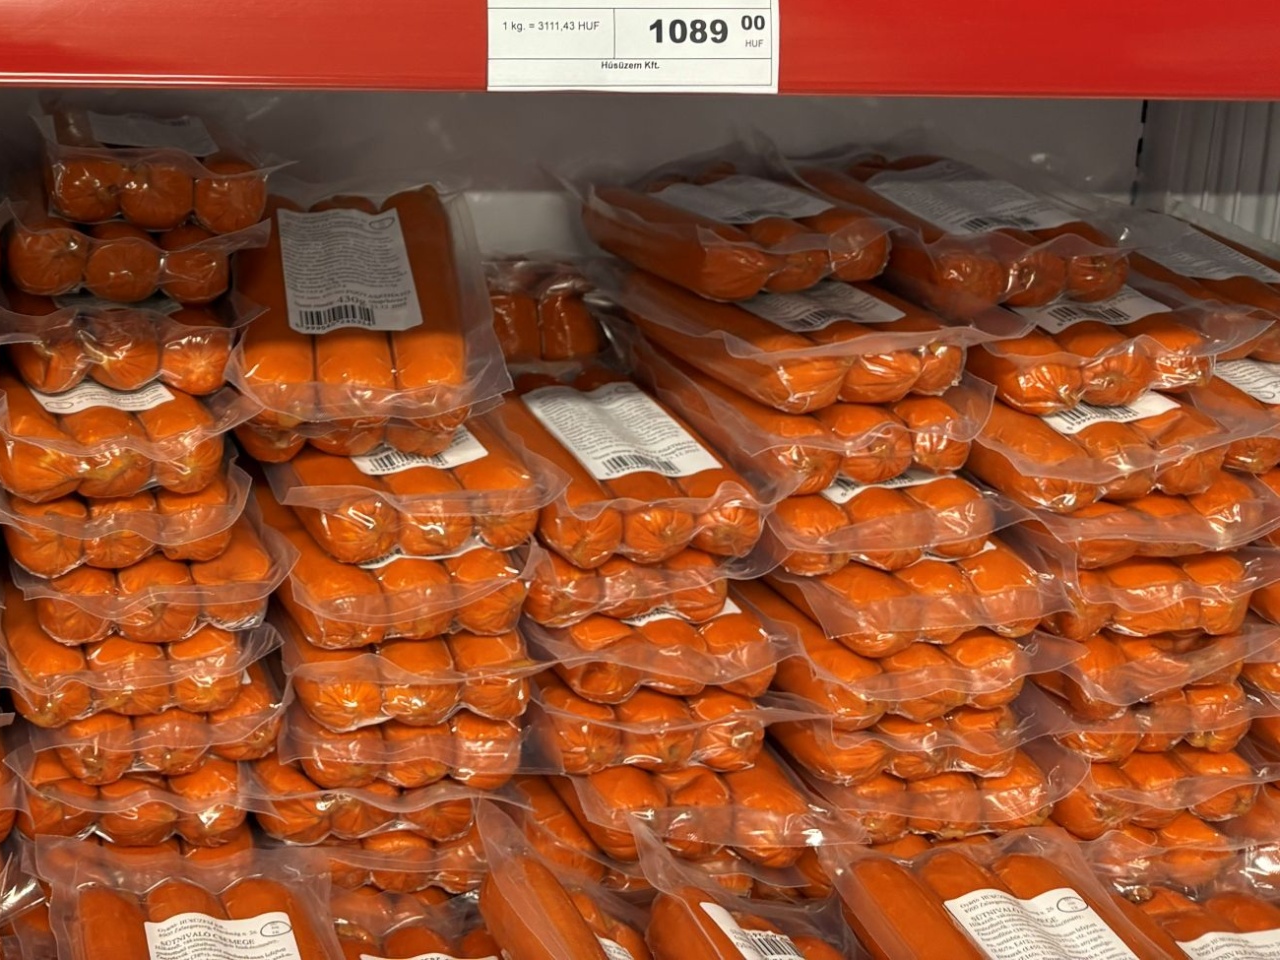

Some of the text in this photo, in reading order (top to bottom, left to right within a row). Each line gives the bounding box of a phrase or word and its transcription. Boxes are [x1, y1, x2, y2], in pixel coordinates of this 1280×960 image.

[503, 21, 507, 31] 1
[511, 21, 526, 33] kg.
[538, 21, 575, 32] 3111,43
[578, 21, 600, 31] HUF
[649, 15, 766, 44] 1089 00
[745, 40, 764, 48] HUF
[644, 61, 660, 69] Kft.
